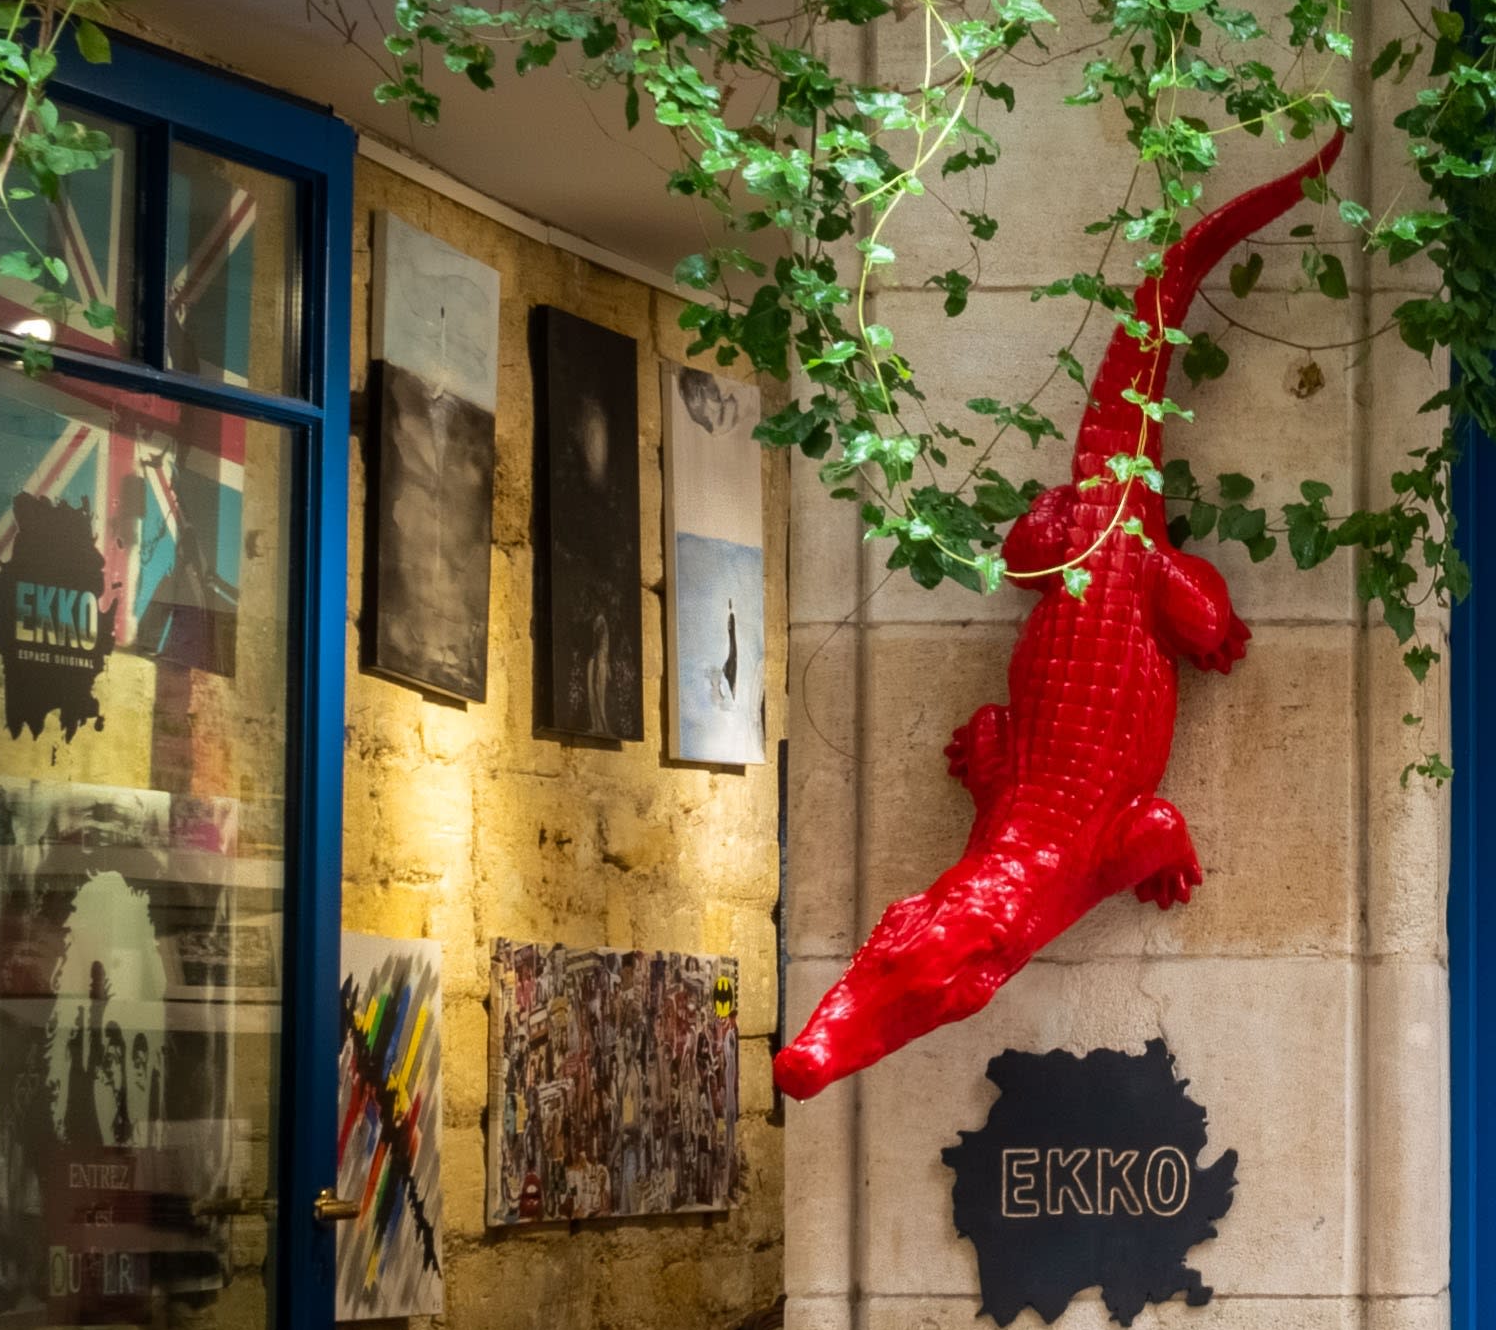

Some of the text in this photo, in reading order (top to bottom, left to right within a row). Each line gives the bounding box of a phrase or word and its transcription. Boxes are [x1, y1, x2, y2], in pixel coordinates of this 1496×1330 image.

[15, 580, 99, 652] EKKO
[18, 649, 95, 670] ESPACE ORIGINAL
[69, 1163, 129, 1189] ENTREZ
[1001, 1146, 1190, 1218] EKKO
